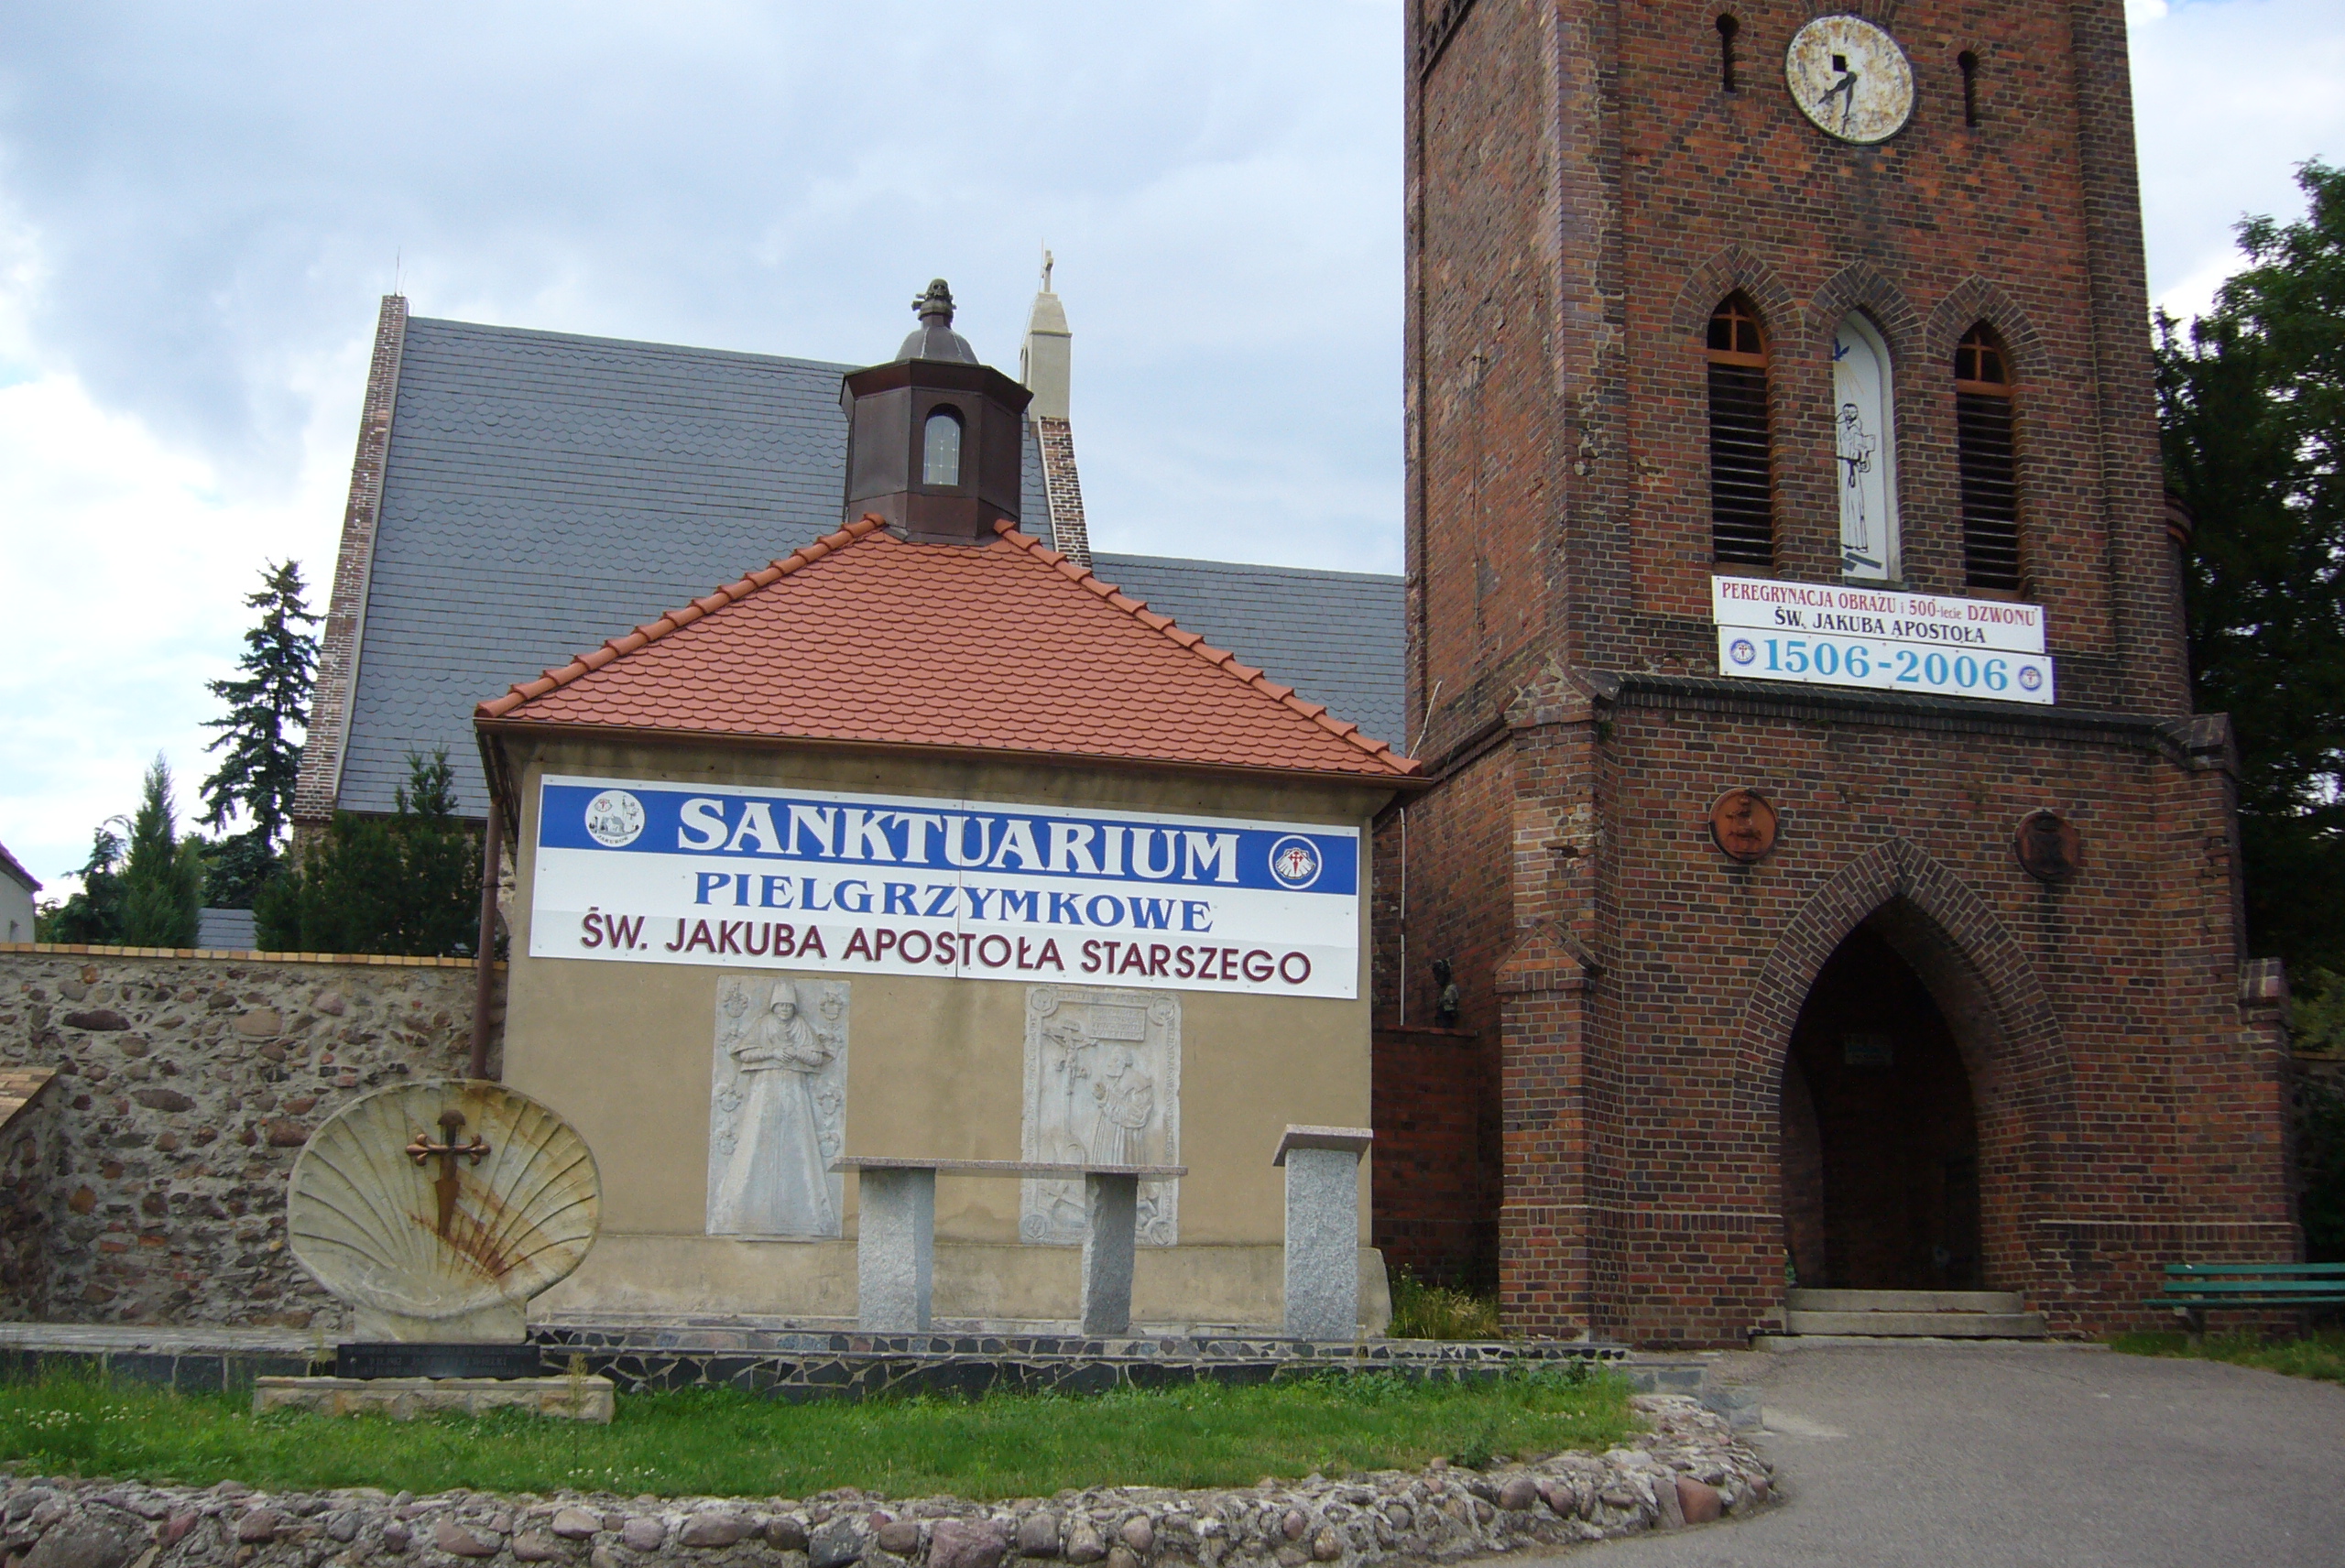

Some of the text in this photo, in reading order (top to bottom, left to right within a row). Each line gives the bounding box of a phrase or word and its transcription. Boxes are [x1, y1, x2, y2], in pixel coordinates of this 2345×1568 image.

[1722, 583, 2035, 627] PEREGRYNACJA OBRAZU i 500-lecie DZWONU
[1774, 605, 1987, 644] ŚW. JAKUBA APOSTOŁA
[1764, 638, 2009, 691] 1506-2006
[679, 798, 1240, 884] SANKTUARIUM
[694, 871, 1214, 933] PIELGRZYMKOWE
[581, 906, 1312, 985] ŚW. JAKUBA APOSTOŁA STARSZEGO
